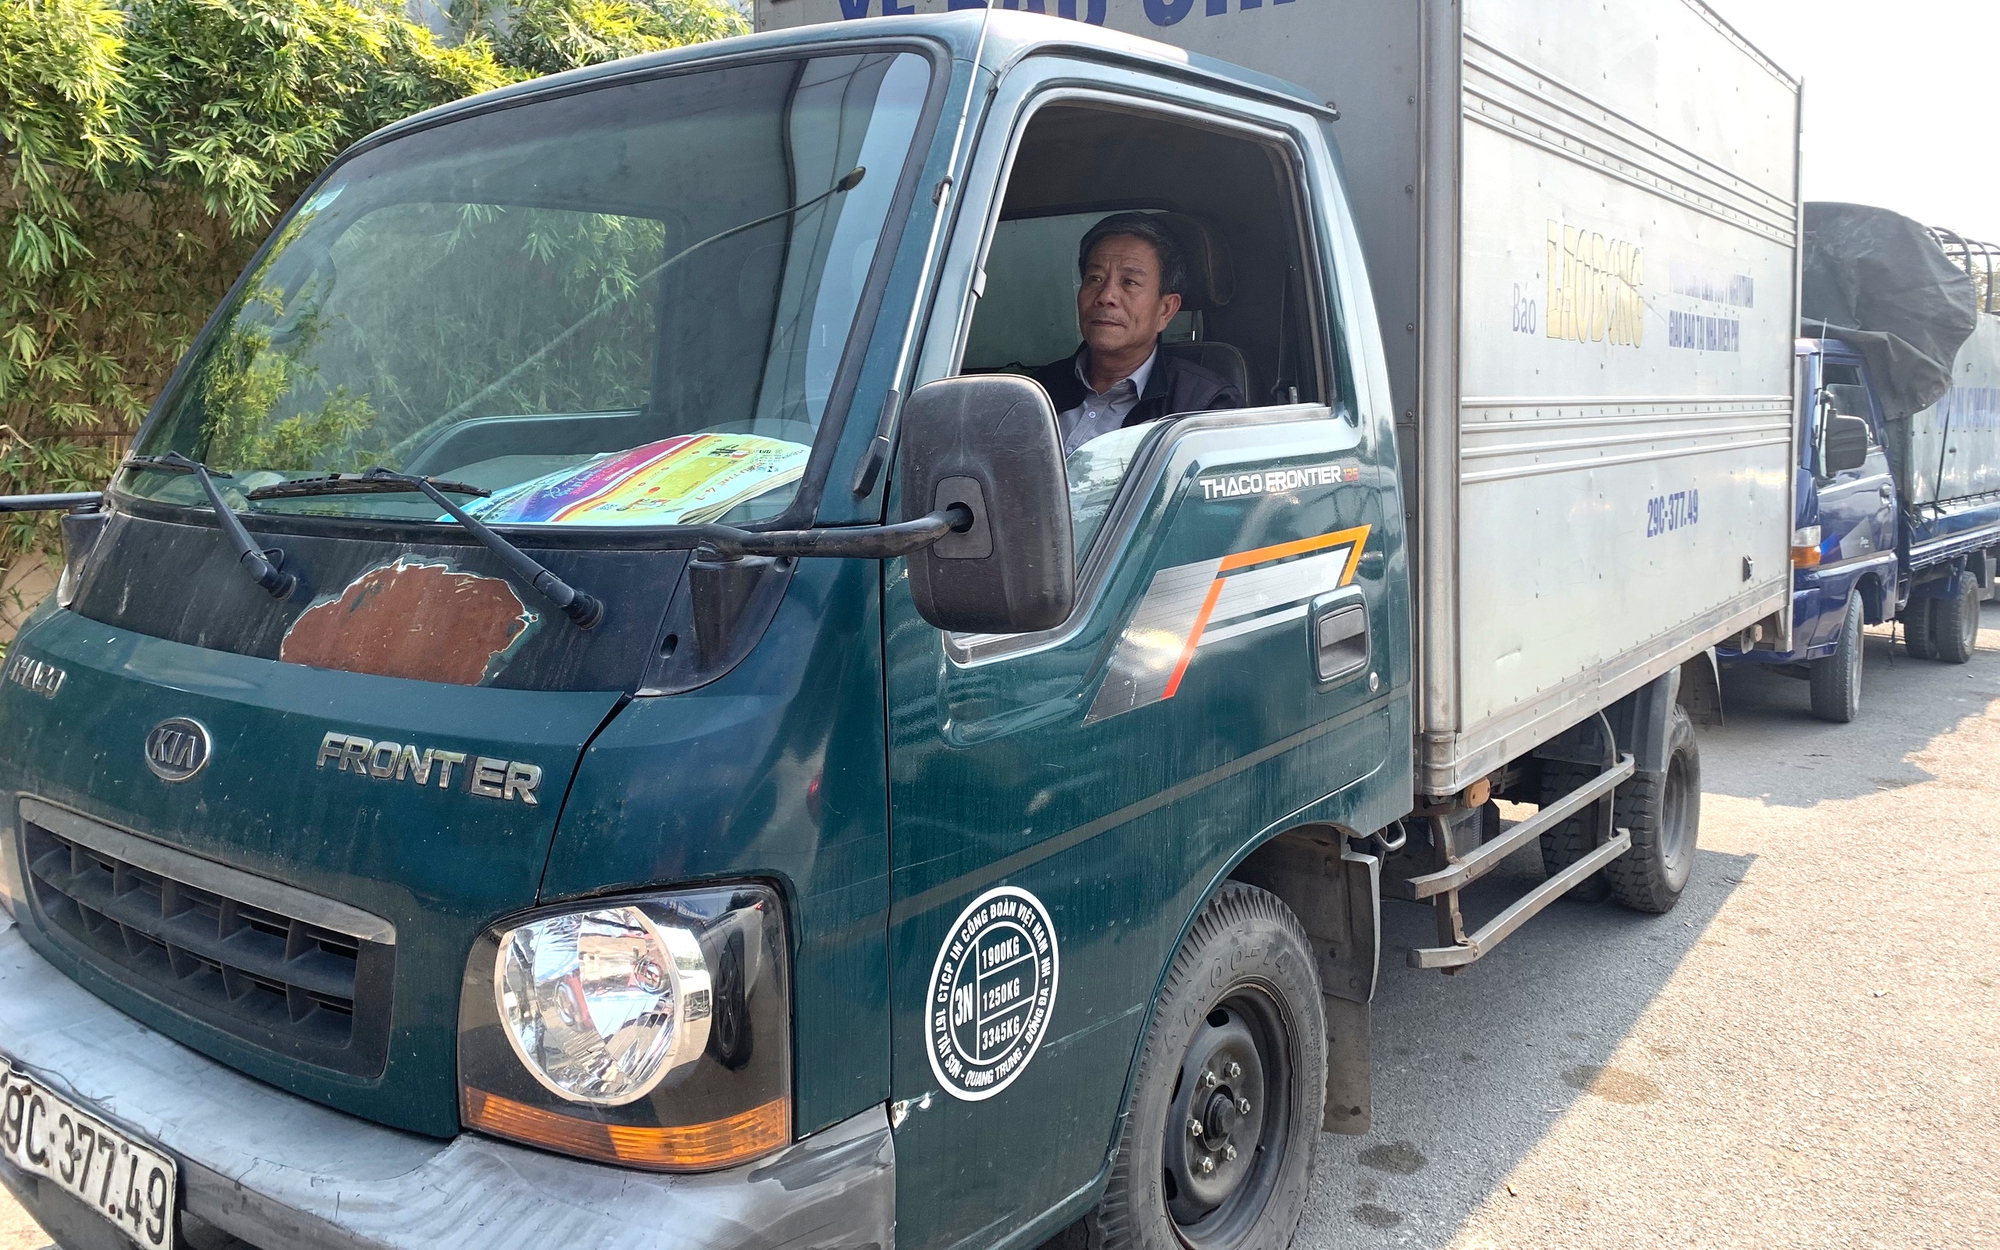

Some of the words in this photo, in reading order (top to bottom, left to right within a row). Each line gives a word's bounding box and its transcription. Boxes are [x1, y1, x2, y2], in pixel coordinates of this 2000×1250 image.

[1512, 282, 1537, 335] Báo
[1200, 474, 1263, 499] THACO
[1265, 465, 1343, 492] FRONTIER
[1647, 488, 1698, 538] 29C-377.49
[151, 728, 197, 769] KIA
[937, 961, 954, 1003] CTCP
[950, 940, 964, 962] IN
[961, 908, 989, 942] CÔNG
[989, 897, 1017, 920] ĐOÀN
[1016, 903, 1036, 930] VIỆT
[1031, 921, 1050, 955] NAM
[981, 935, 1020, 970] 1900KG
[954, 982, 974, 1027] 3N
[982, 977, 1020, 1012] 1250KG
[1039, 986, 1050, 1012] ĐA
[935, 1007, 947, 1033] 167
[982, 1015, 1020, 1051] 3345KG
[936, 1032, 952, 1060] TÂY
[995, 1047, 1023, 1080] TRUNG
[964, 1068, 994, 1088] QUANG
